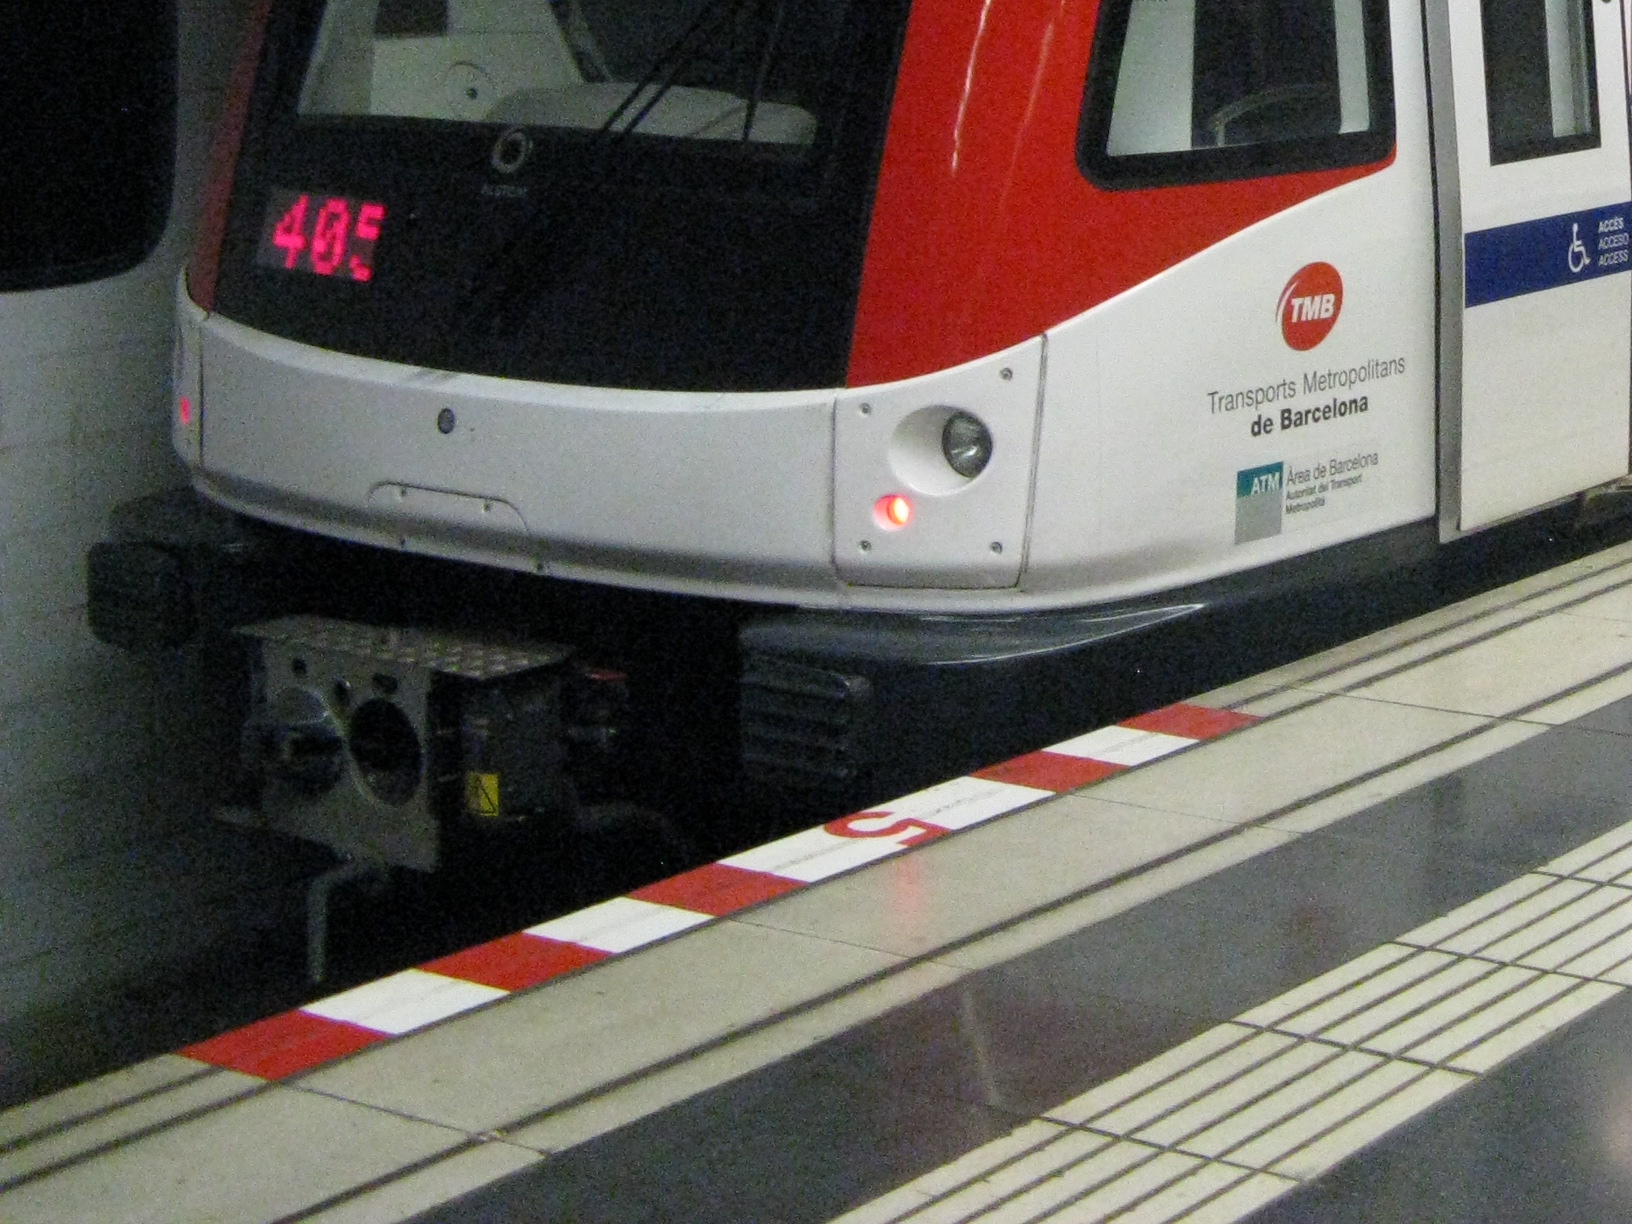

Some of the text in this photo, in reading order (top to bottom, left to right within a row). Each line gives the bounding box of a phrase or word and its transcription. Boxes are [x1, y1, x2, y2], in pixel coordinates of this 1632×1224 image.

[272, 193, 387, 282] 405
[1597, 232, 1629, 250] ACCESO
[1598, 249, 1629, 267] ACCESS
[1291, 293, 1336, 323] TMB
[1207, 356, 1406, 414] Transports Metropolitans
[1250, 395, 1370, 437] de Barcelona
[1313, 463, 1327, 480] de
[1329, 453, 1379, 476] Barcelona
[1250, 471, 1281, 496] ATM
[823, 810, 953, 848] 5
